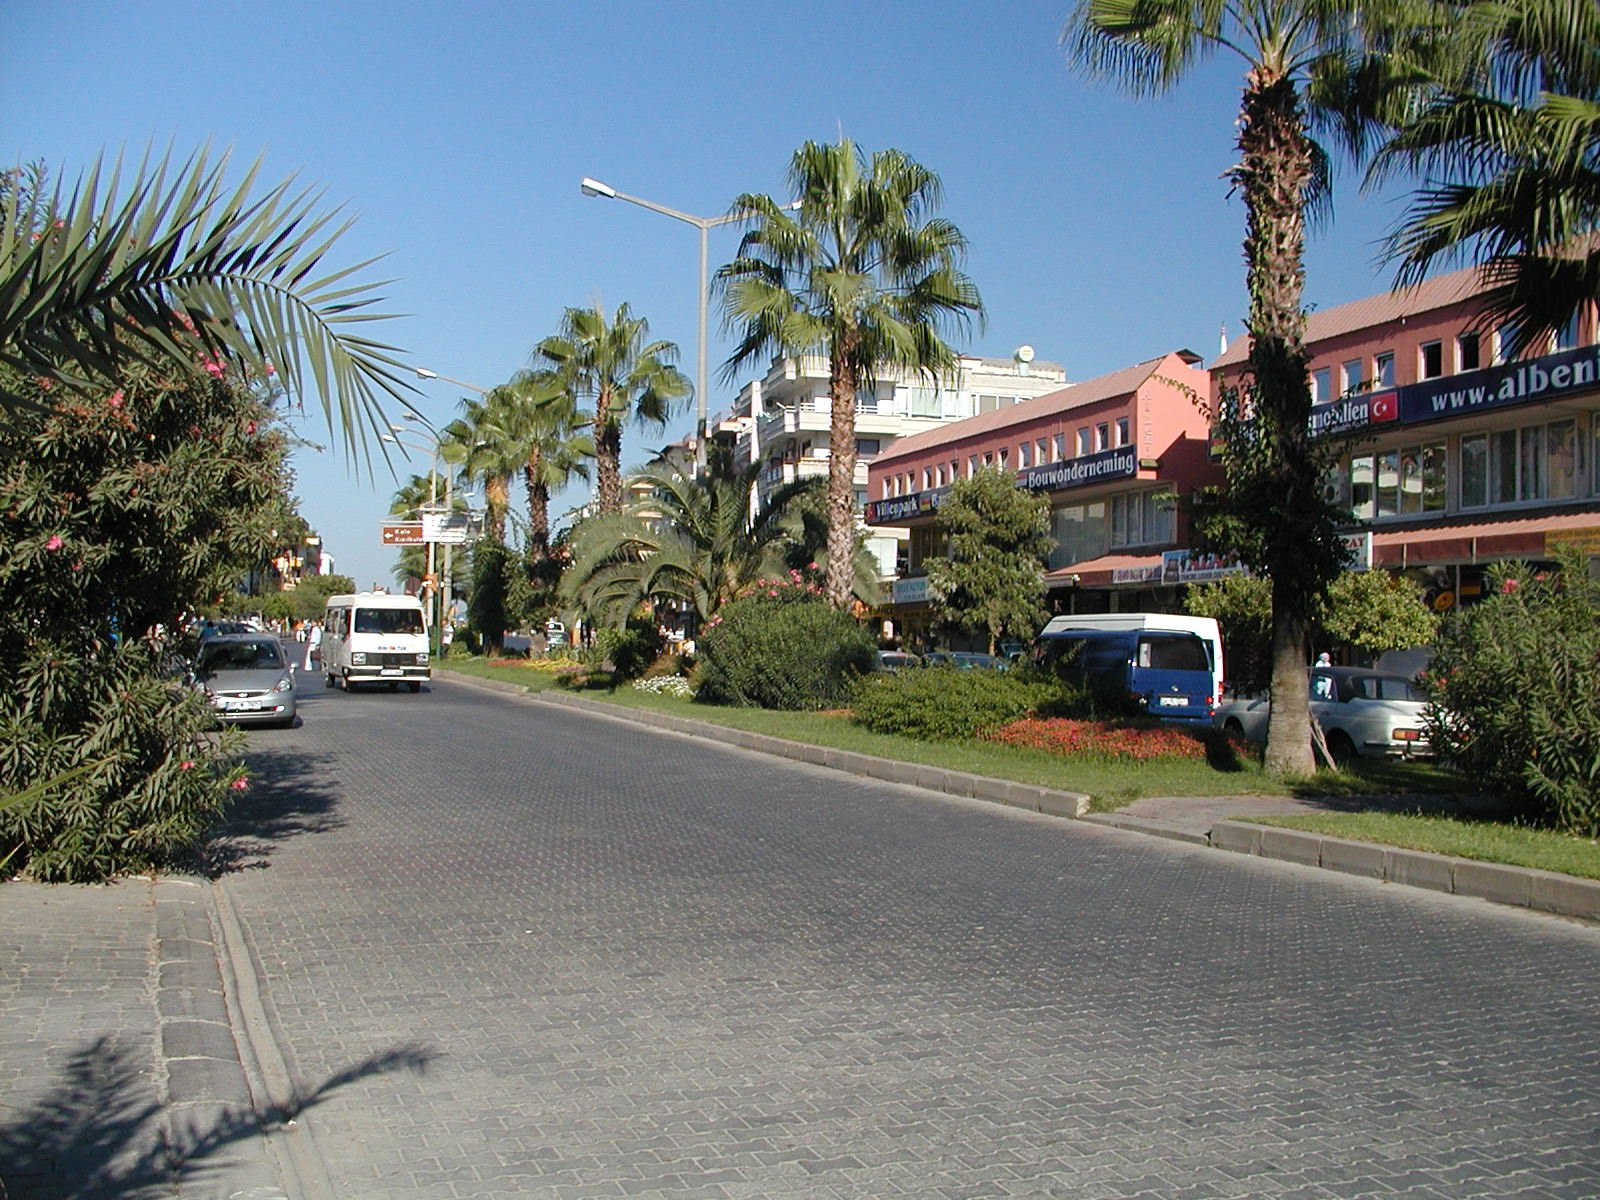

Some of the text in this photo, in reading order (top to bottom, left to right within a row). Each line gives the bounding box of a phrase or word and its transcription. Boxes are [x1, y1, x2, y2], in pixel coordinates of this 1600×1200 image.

[1431, 351, 1600, 412] www.alben
[1028, 452, 1134, 488] Bouwonderneming
[876, 497, 918, 518] Villenpark
